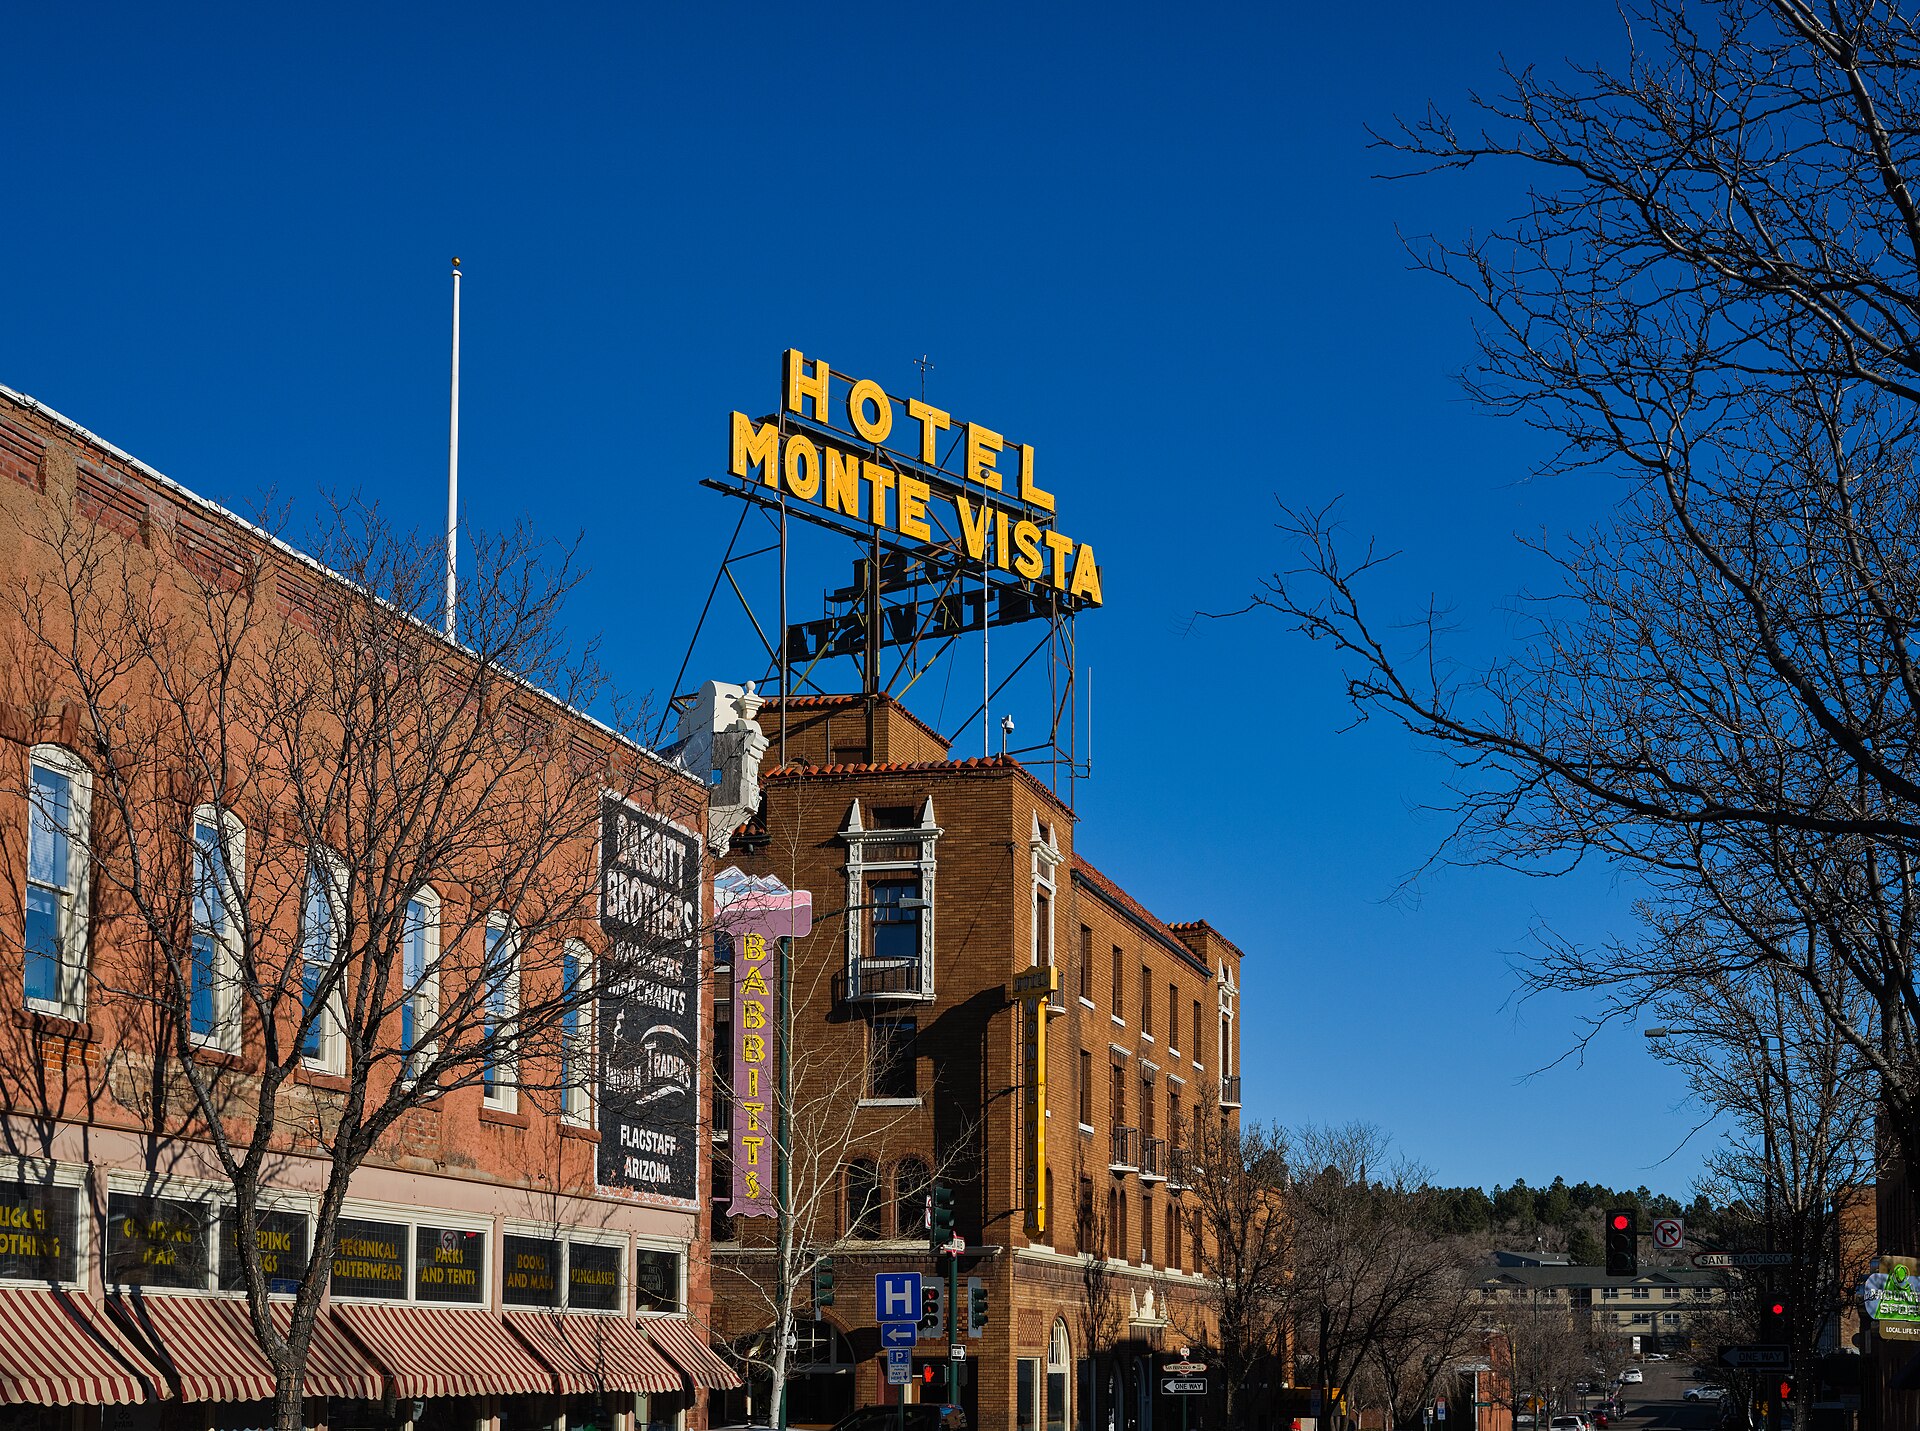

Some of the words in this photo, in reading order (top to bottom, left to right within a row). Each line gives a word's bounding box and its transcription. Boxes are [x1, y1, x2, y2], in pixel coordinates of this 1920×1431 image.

[785, 347, 1055, 512] HOTEL
[730, 410, 931, 542] MONTE
[955, 494, 1103, 605] VISTA
[606, 868, 694, 948] BROTHERS
[1015, 972, 1047, 992] HOTEL
[1026, 996, 1036, 1104] MONTE
[644, 1041, 691, 1089] TRADERS
[740, 932, 770, 1199] BABBITTS
[620, 1124, 676, 1156] FLAGSTAFF
[624, 1155, 671, 1184] ARIZONA
[1026, 1120, 1035, 1229] VISTA
[340, 1238, 397, 1260] TECHNICAL
[435, 1247, 464, 1265] PACKS
[1701, 1255, 1724, 1265] SAN
[1727, 1255, 1787, 1264] FRANCISCO
[333, 1260, 402, 1281] OUTERWEAR
[517, 1253, 545, 1271] BOOKS
[421, 1266, 445, 1284] AND
[447, 1268, 476, 1286] TENTS
[507, 1272, 528, 1289] AND
[571, 1268, 616, 1287] SUNGLASSES
[885, 1280, 912, 1315] H
[895, 1351, 904, 1363] P
[1738, 1352, 1759, 1361] ONE
[1761, 1352, 1781, 1360] WAY
